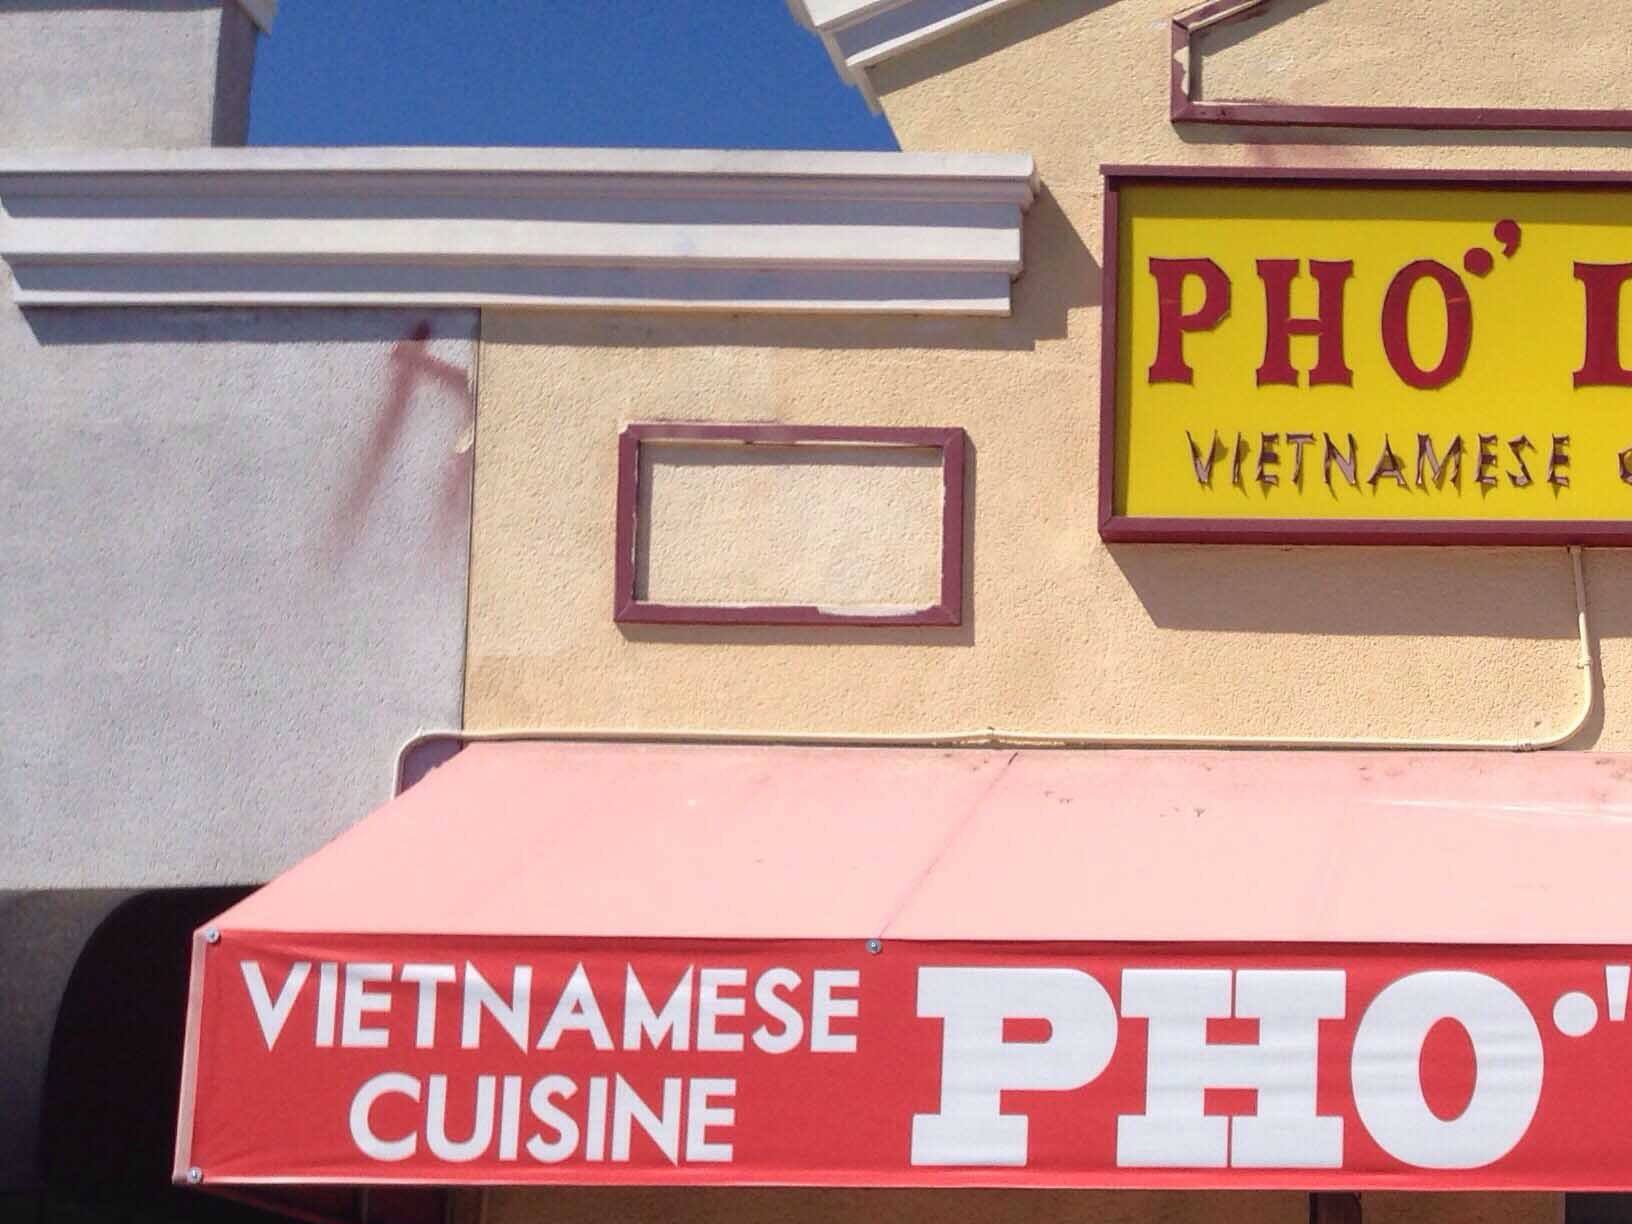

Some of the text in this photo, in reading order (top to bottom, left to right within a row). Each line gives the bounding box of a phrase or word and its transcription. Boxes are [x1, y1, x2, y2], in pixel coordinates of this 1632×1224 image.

[1186, 430, 1571, 496] VIETNAMESE
[240, 960, 860, 1053] VIETNAMESE
[349, 1072, 737, 1167] CUISINE
